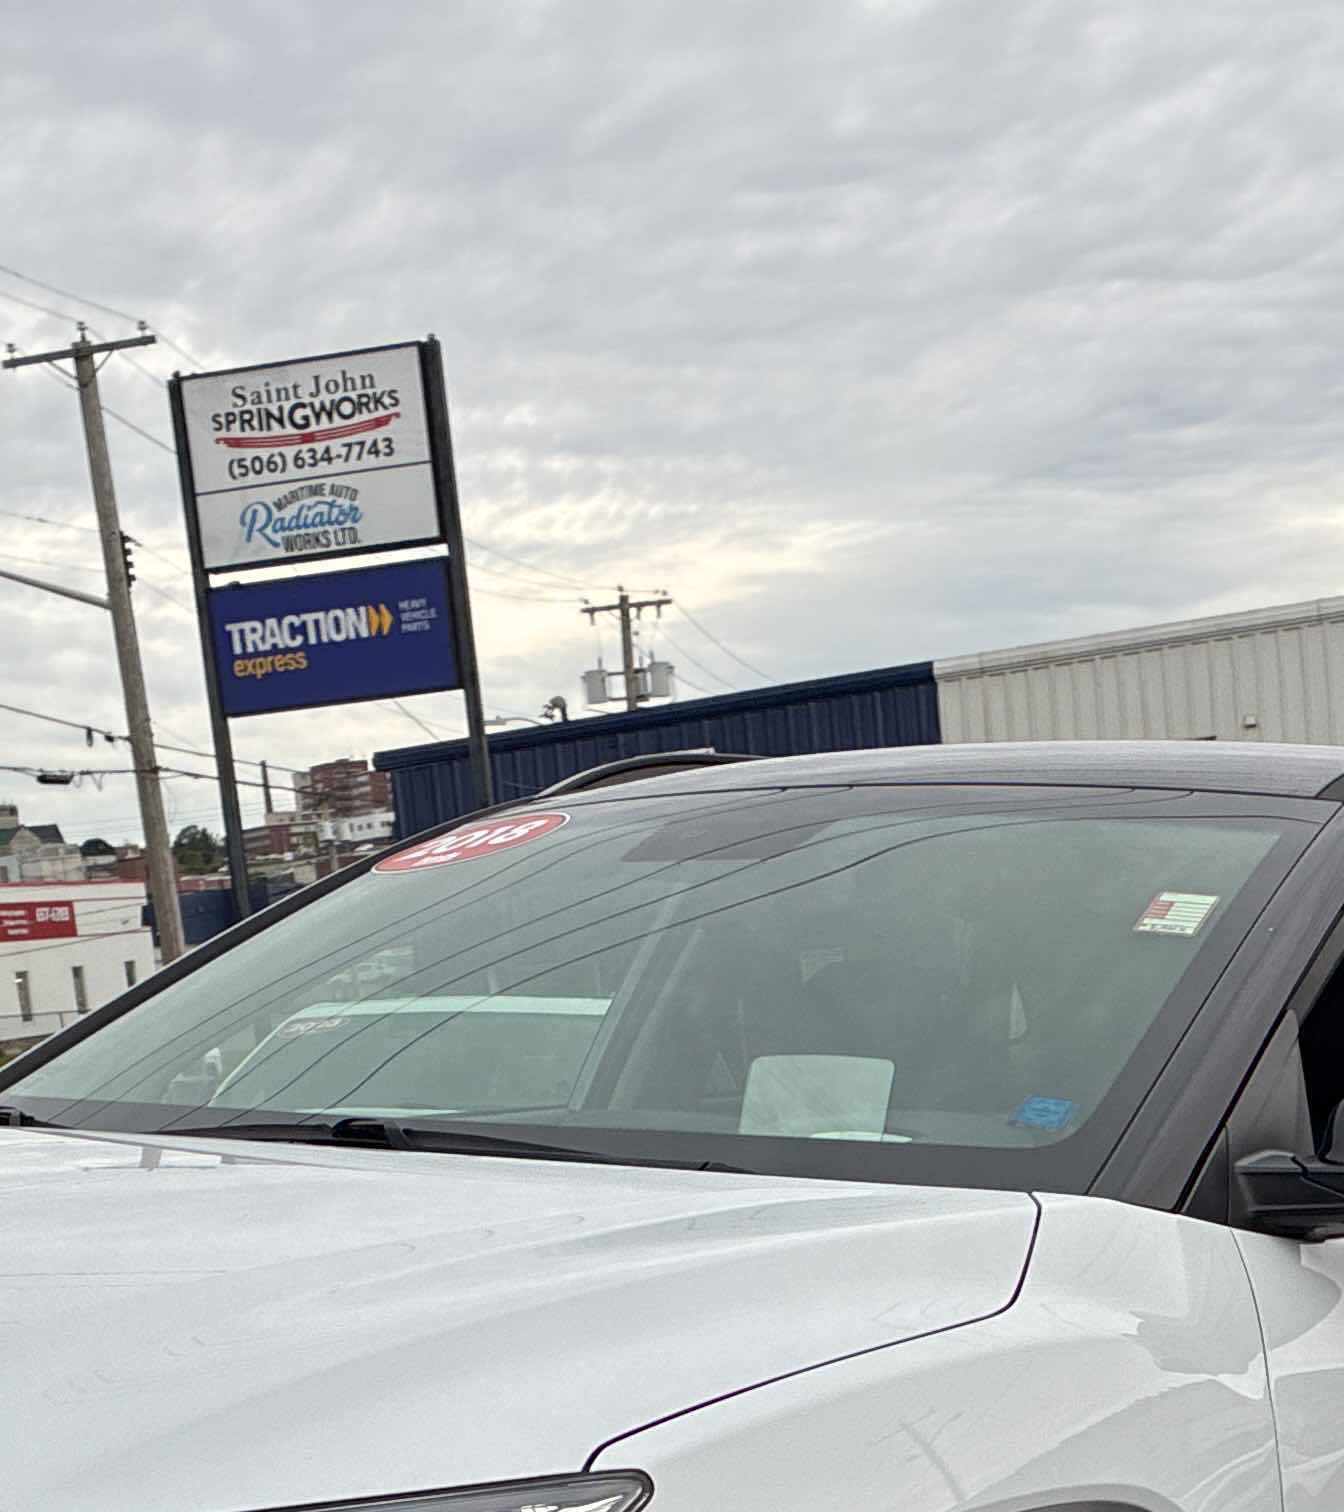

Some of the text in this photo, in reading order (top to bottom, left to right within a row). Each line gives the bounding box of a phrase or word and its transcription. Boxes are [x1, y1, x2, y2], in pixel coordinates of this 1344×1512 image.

[231, 369, 377, 408] Saint John
[211, 389, 401, 432] SPRINGWORKS
[228, 436, 396, 480] (506) 634-7743
[272, 482, 359, 512] MARITIME AUTO
[239, 499, 362, 548] Radiator
[281, 529, 333, 553] WORKS
[224, 605, 370, 655] TRACTION
[233, 650, 309, 679] express
[392, 818, 550, 863] 2018
